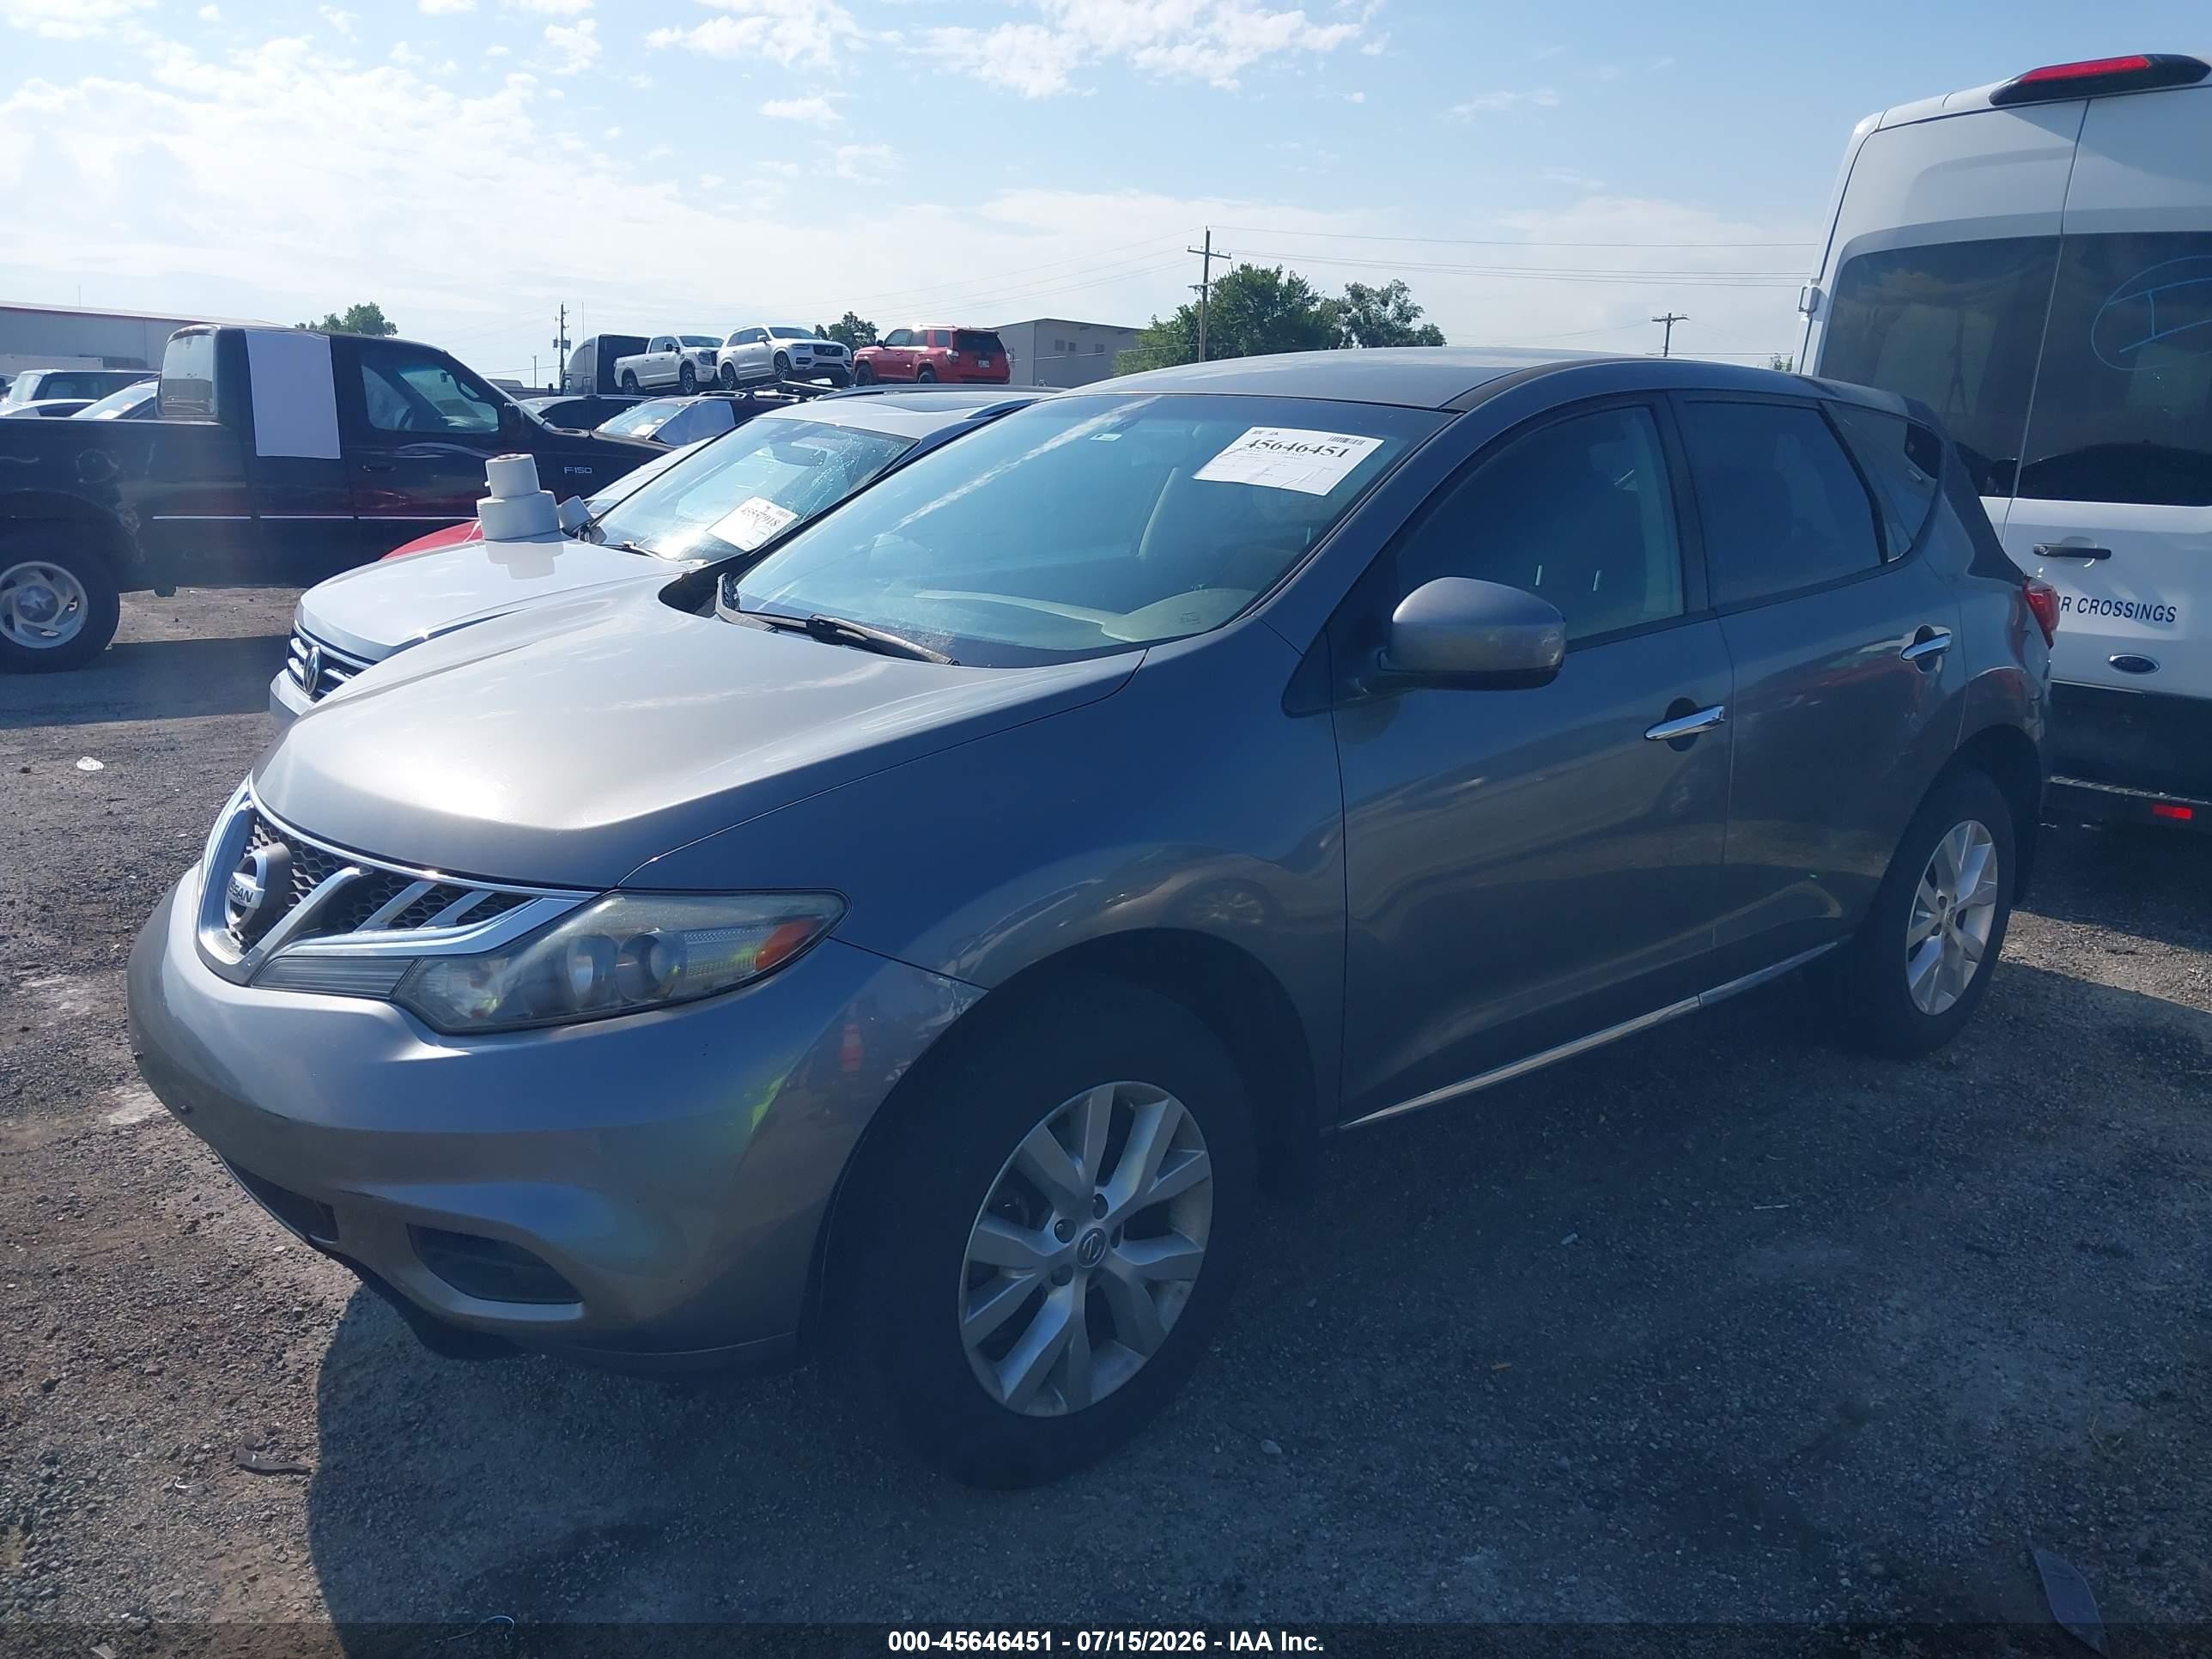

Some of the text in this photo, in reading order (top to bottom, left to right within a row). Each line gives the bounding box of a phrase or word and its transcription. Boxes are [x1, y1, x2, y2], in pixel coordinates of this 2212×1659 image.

[1245, 439, 1351, 458] 45646451
[2057, 596, 2177, 623] R CROSSINGS
